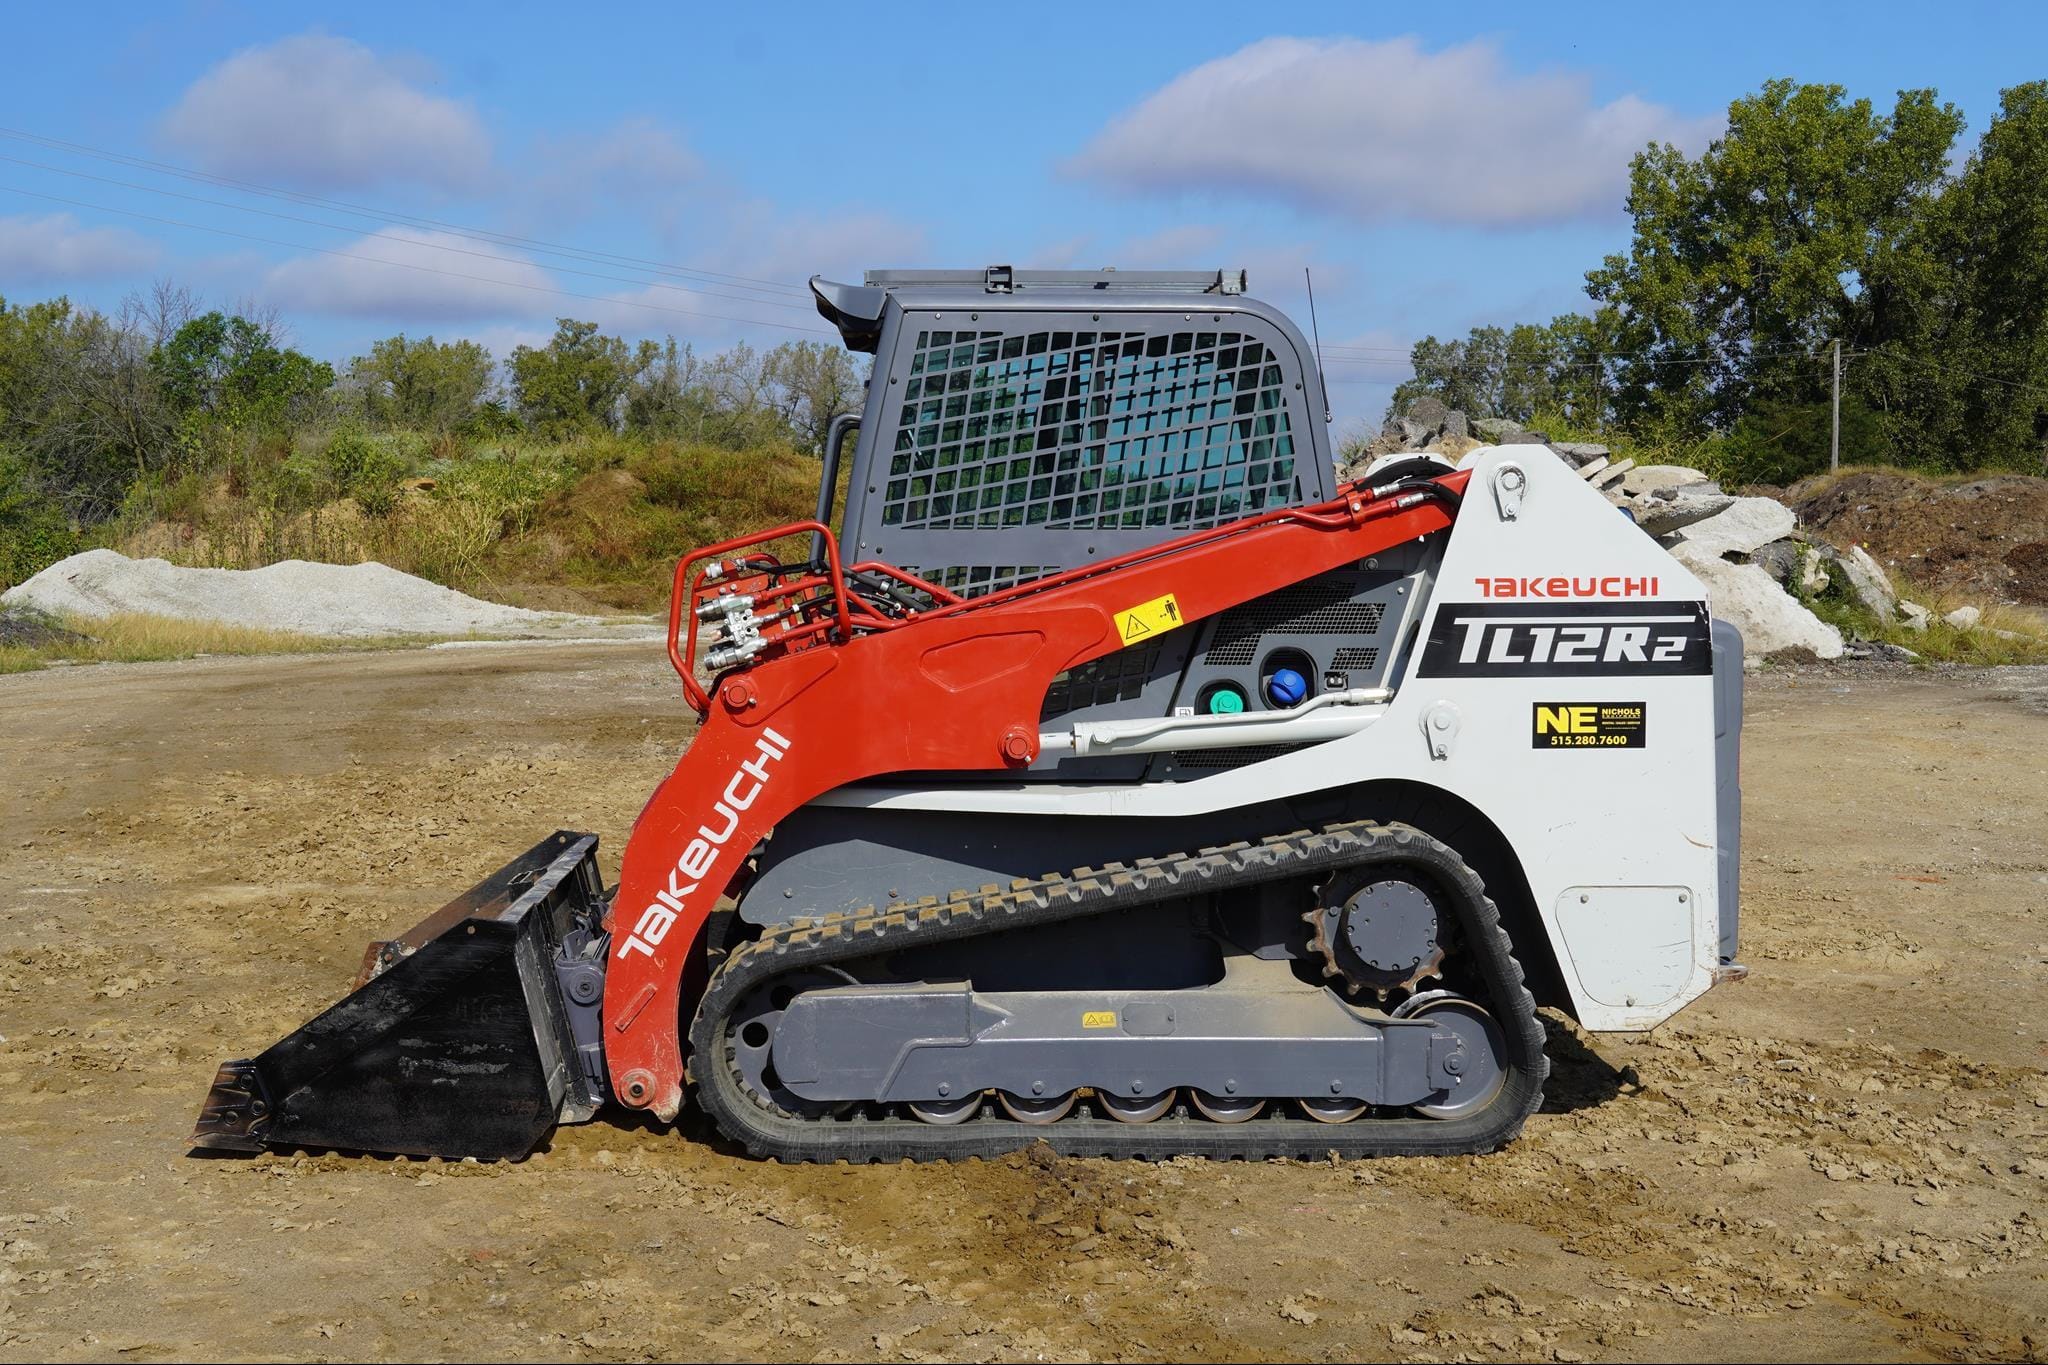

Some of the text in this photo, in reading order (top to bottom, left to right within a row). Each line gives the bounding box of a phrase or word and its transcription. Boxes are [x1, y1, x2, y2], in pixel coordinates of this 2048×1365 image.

[1454, 615, 1696, 664] TL12R2
[1536, 706, 1598, 734] NE
[1602, 708, 1641, 716] NICHOLS
[1550, 735, 1627, 746] 515.280.7600
